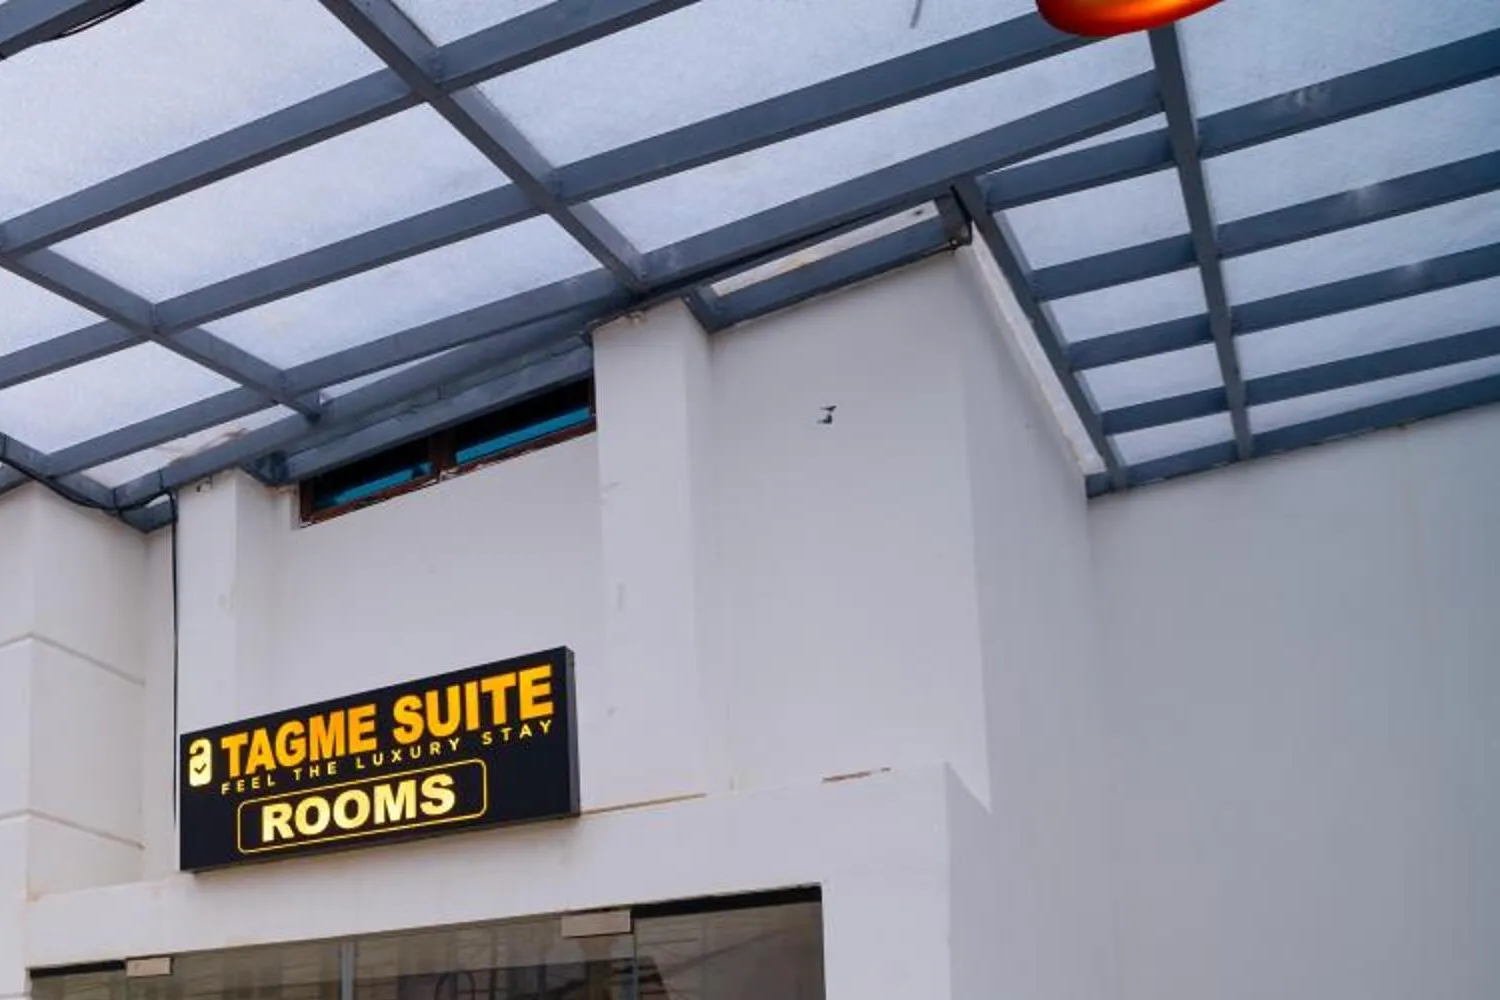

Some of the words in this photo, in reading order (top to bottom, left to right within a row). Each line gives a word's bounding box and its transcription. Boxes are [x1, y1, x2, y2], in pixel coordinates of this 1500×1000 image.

[221, 704, 377, 778] TAGME
[393, 664, 554, 744] SUITE
[221, 774, 276, 795] FEEL
[294, 762, 337, 780] THE
[356, 738, 460, 769] LUXURY
[481, 720, 551, 745] STAY
[262, 773, 457, 842] ROOMS
